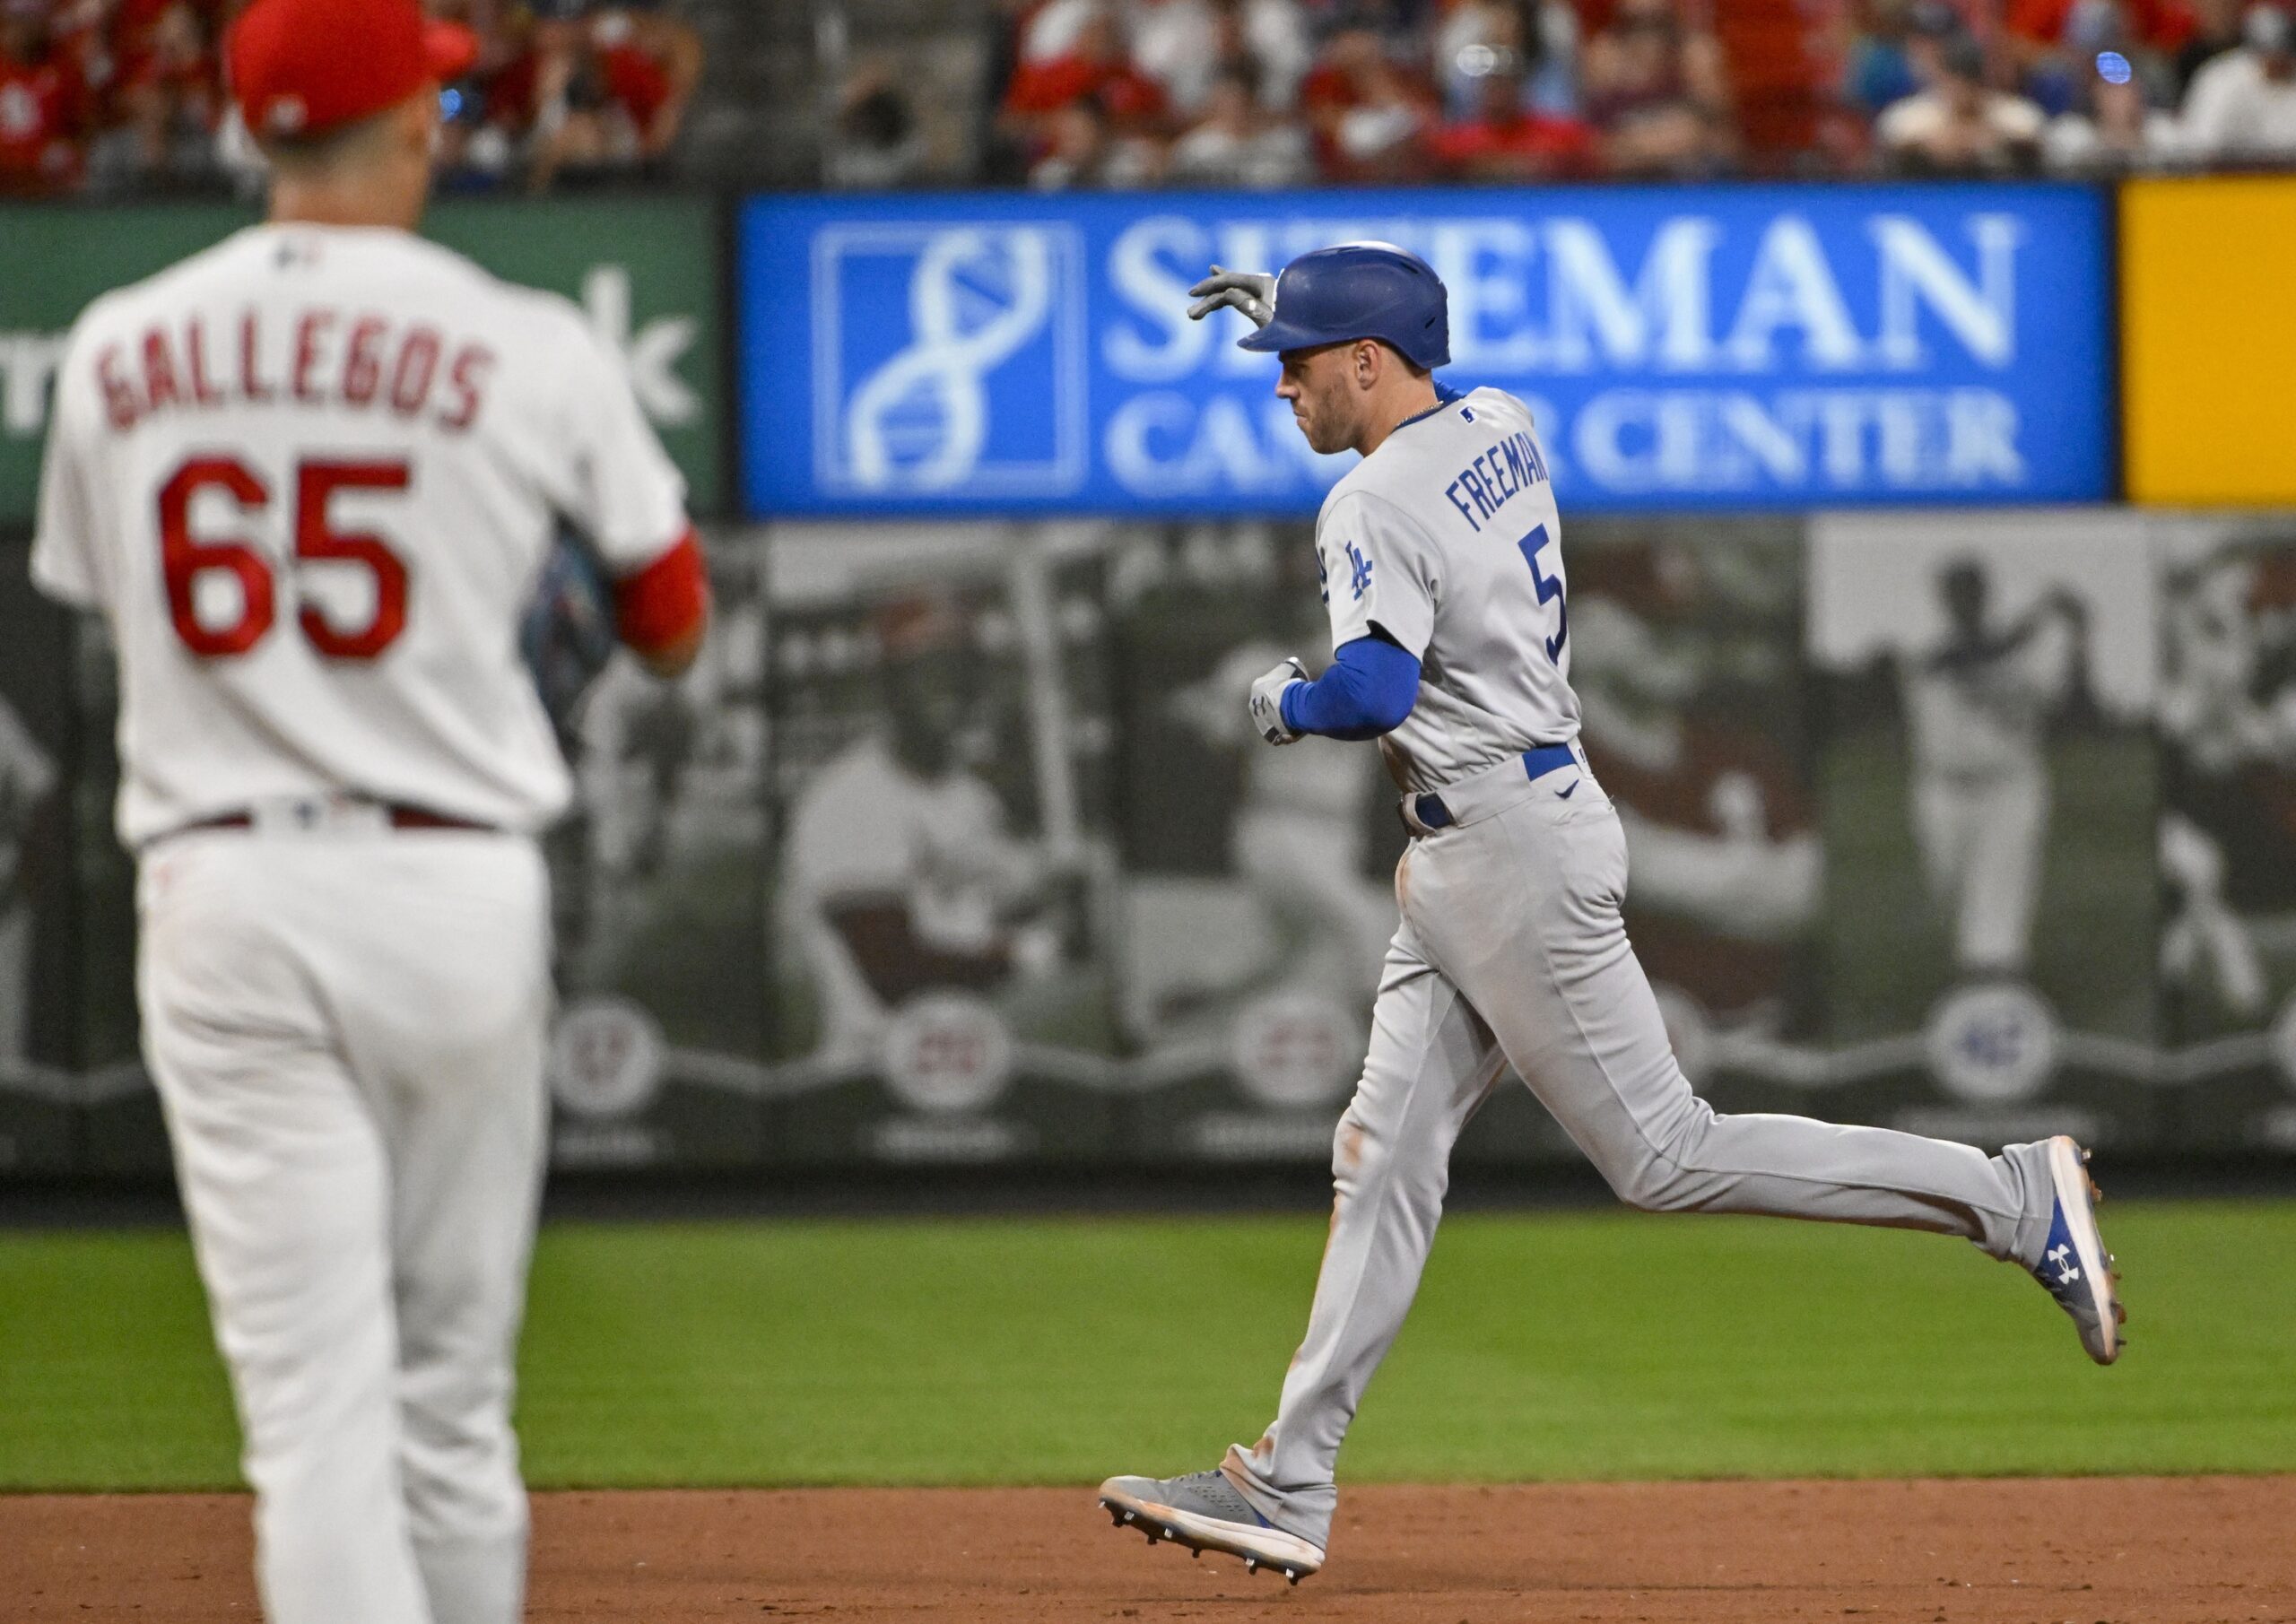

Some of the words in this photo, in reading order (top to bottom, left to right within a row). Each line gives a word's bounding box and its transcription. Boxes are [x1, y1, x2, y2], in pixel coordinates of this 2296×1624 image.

[97, 305, 496, 432] GALLEGOS
[1445, 431, 1549, 533] FREEMAN
[1571, 387, 2025, 491] CENTER
[157, 453, 413, 662] 65
[1518, 523, 1568, 666] 5
